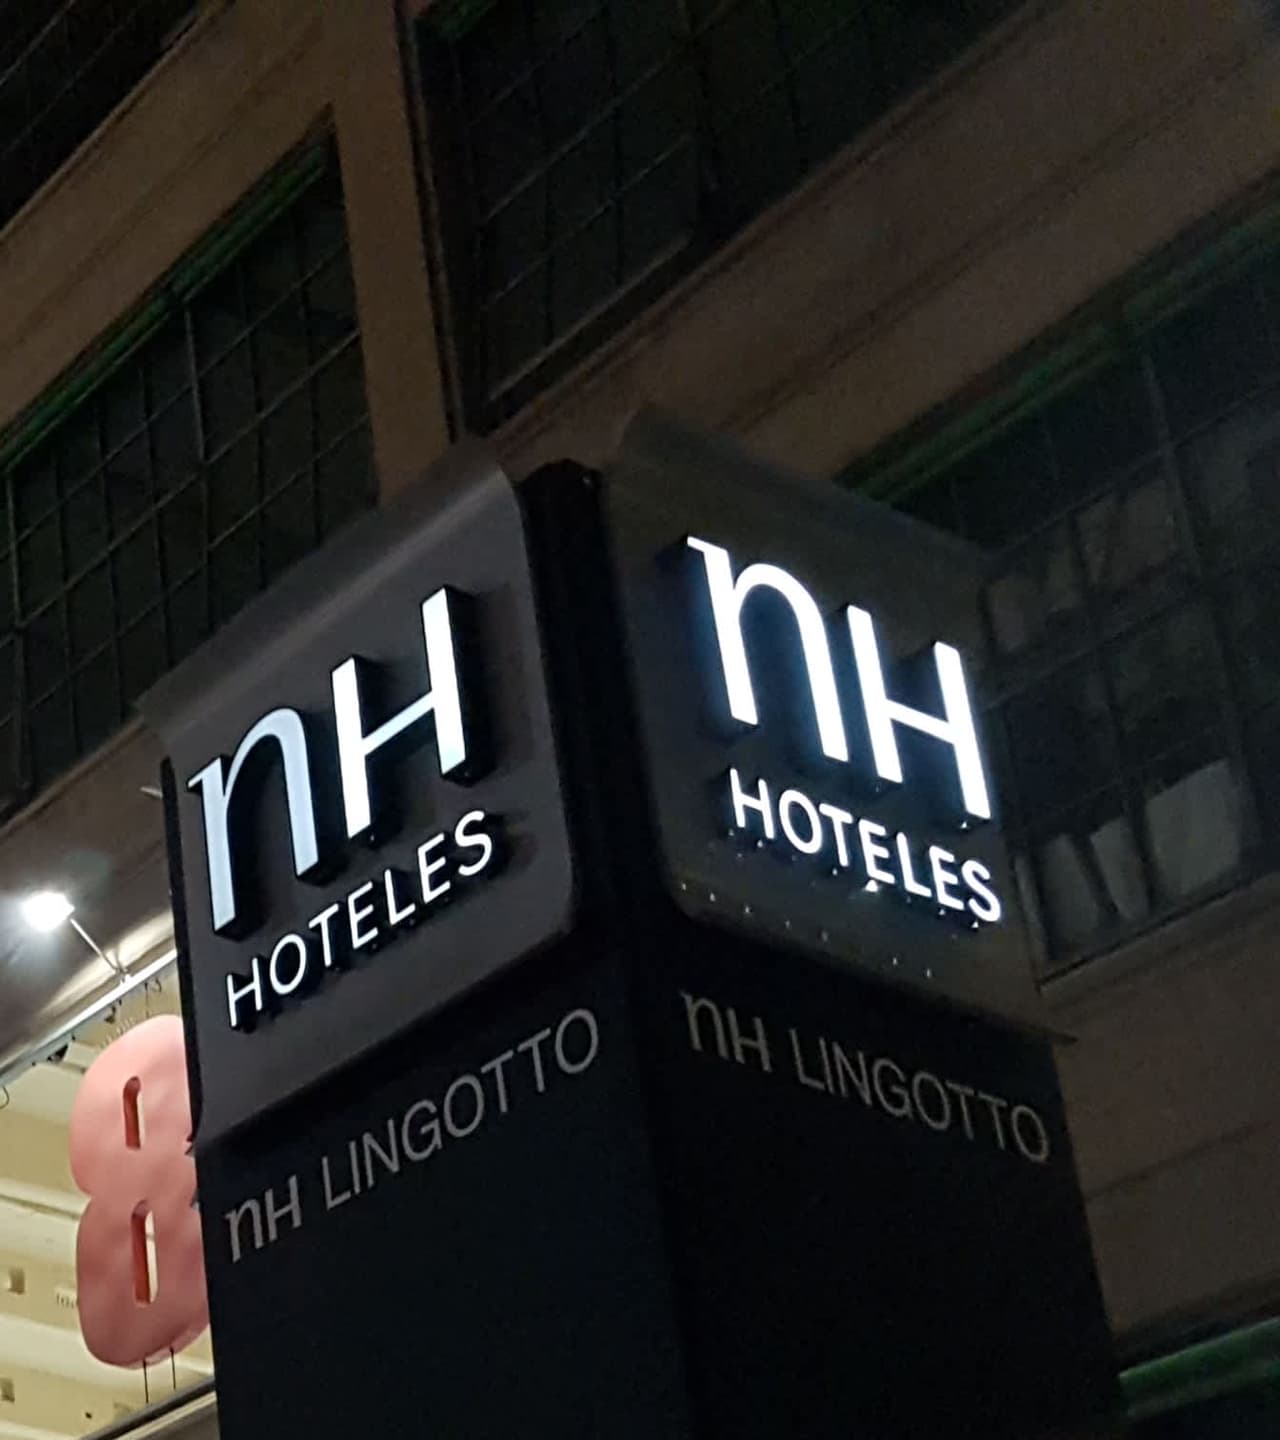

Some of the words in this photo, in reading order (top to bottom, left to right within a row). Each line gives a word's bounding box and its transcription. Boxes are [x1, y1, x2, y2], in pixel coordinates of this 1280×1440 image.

[226, 810, 494, 1028] HOTELES
[727, 769, 1003, 924] HOTELES
[319, 1007, 601, 1209] LINGOTTO
[792, 1028, 1052, 1165] LINGOTTO
